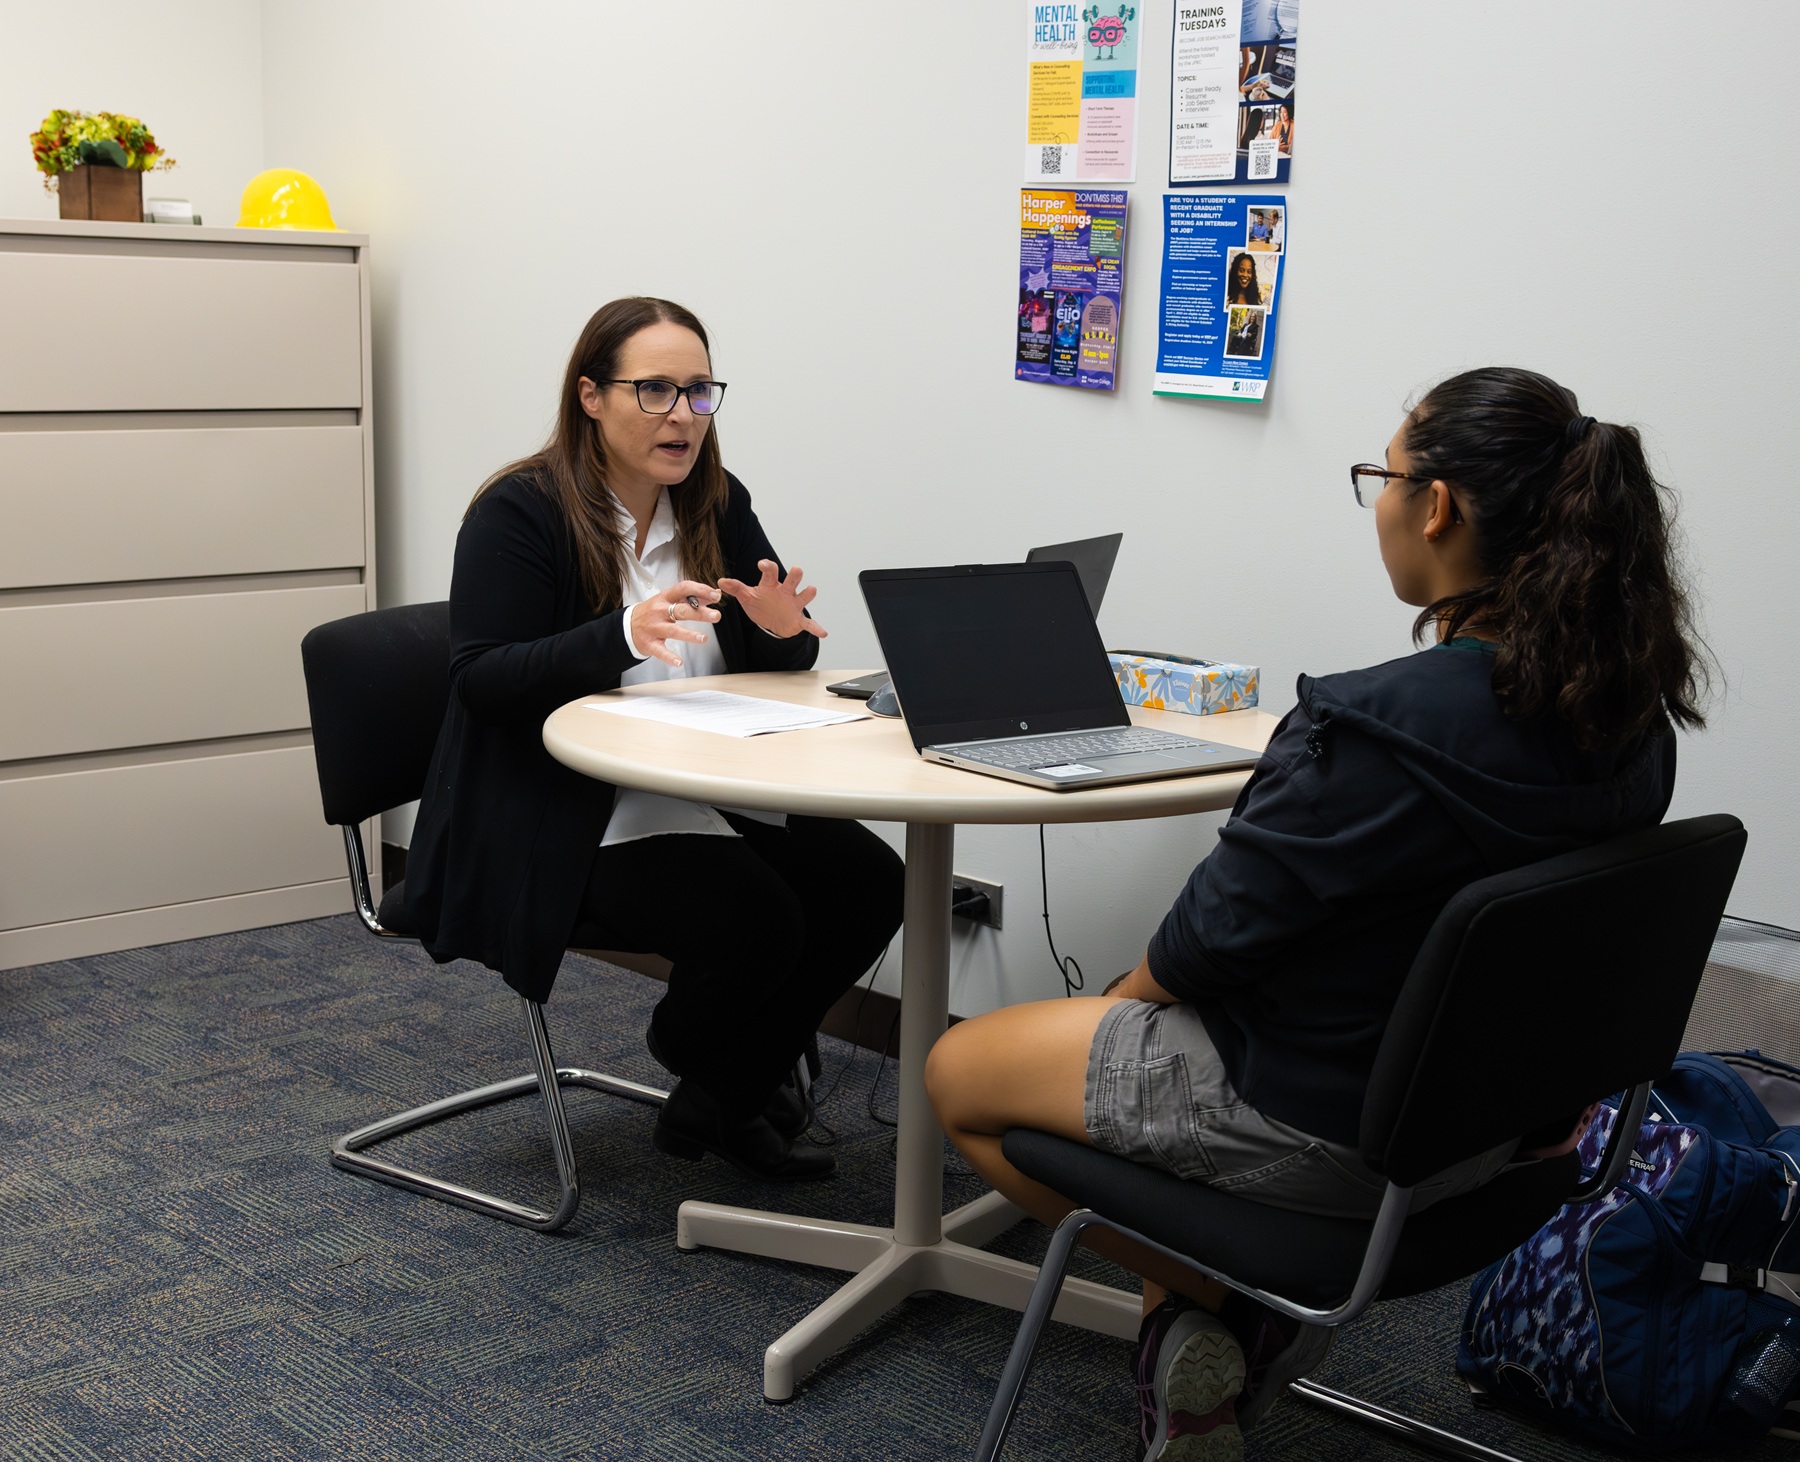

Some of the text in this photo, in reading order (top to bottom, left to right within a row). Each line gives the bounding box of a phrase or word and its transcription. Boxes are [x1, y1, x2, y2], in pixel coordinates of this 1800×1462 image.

[1035, 4, 1078, 23] MENTAL
[1180, 6, 1224, 19] TRAINING
[1180, 18, 1226, 31] TUESDAYS
[1035, 24, 1076, 42] HEALTH
[1040, 40, 1078, 55] well-being
[1085, 75, 1115, 84] SUPPORTING
[1085, 85, 1125, 95] MENTAL HEALTH
[1022, 194, 1066, 212] Harper
[1096, 194, 1110, 203] MISS
[1022, 208, 1091, 229] Happenings
[1241, 381, 1260, 393] WRP
